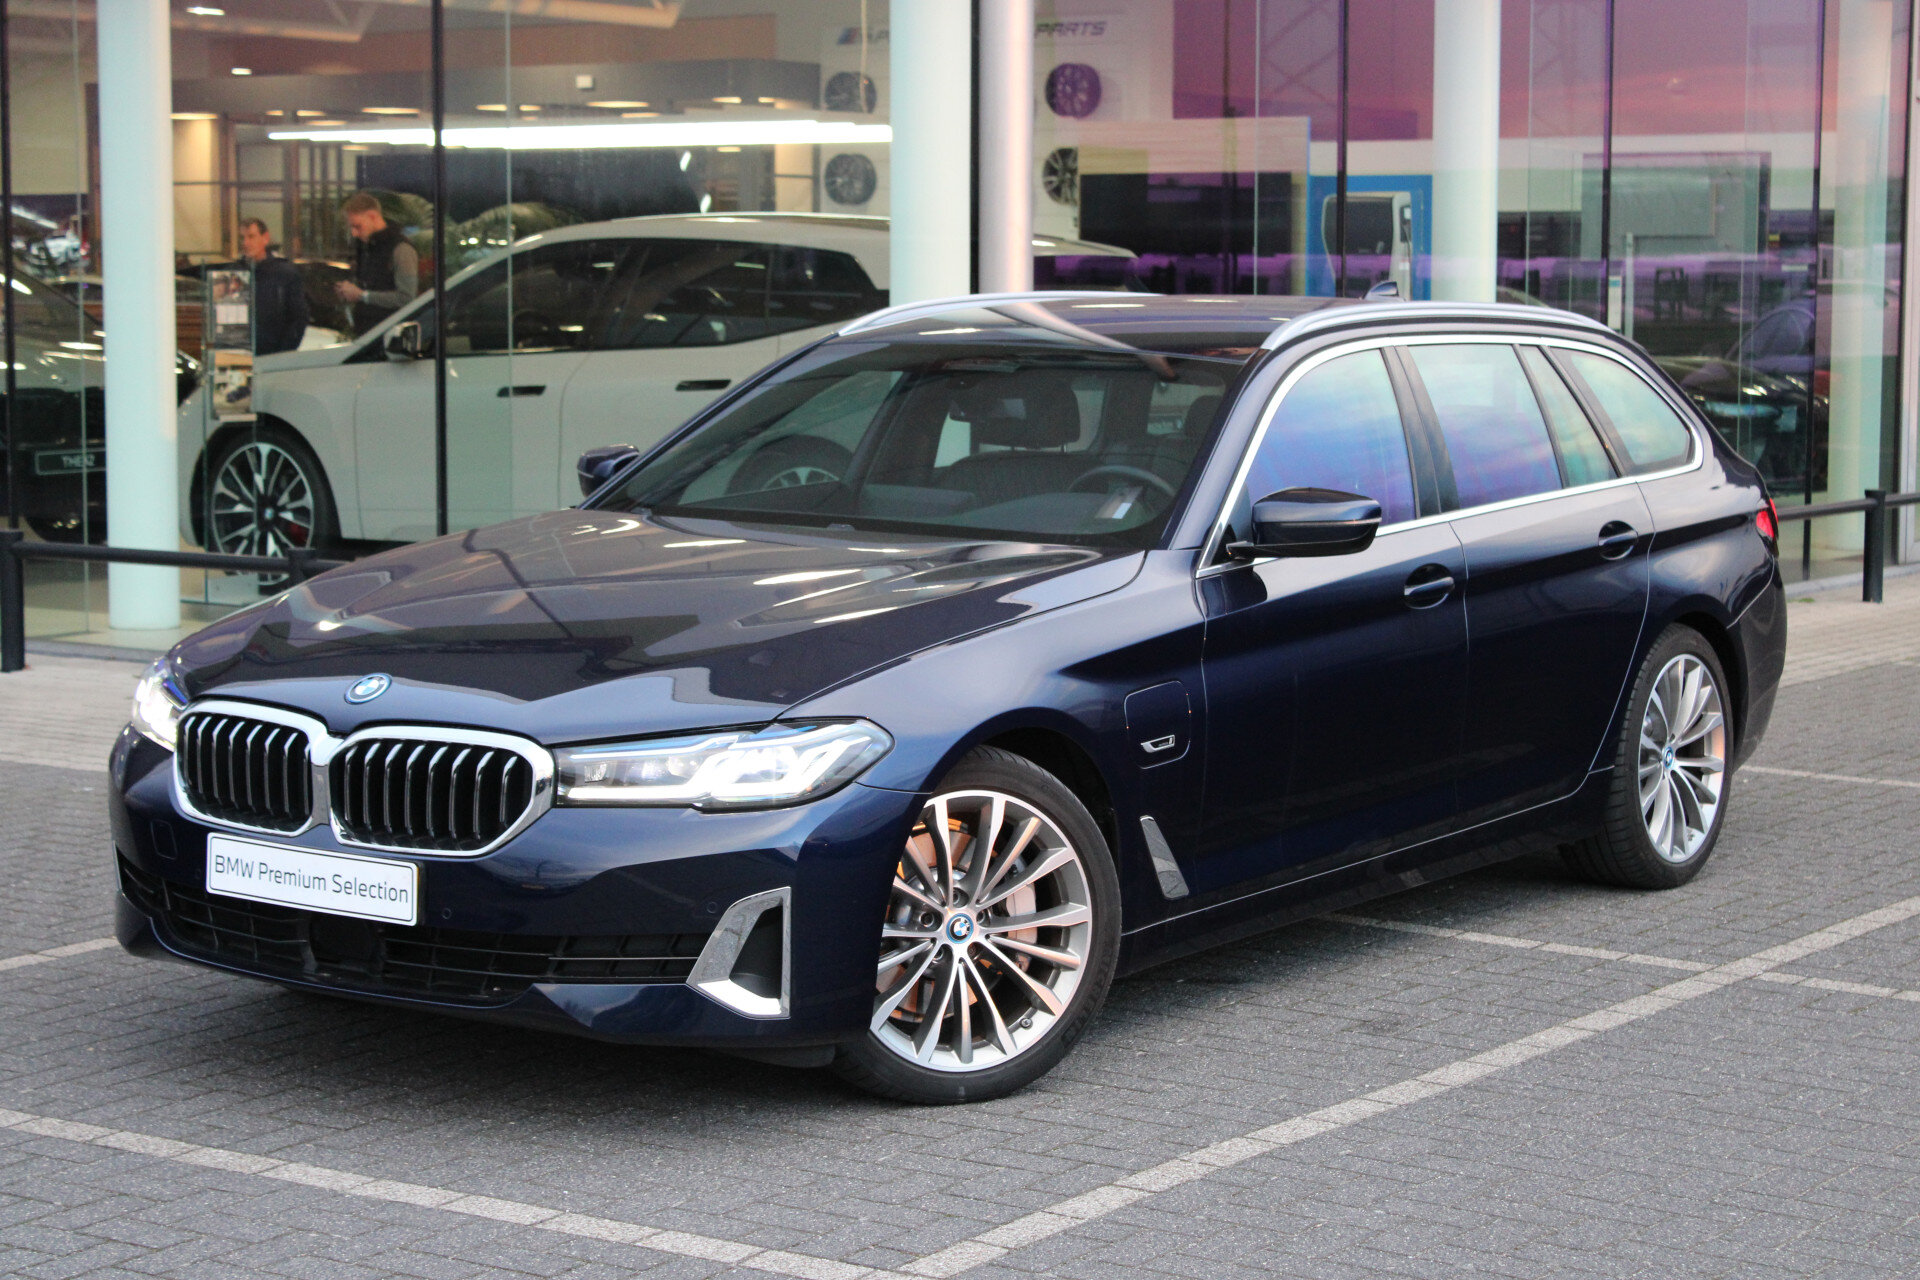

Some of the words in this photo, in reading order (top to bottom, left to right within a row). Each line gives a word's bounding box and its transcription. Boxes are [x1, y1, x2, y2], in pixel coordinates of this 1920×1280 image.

[215, 855, 254, 878] BMW
[259, 862, 326, 891] Premium
[332, 874, 408, 903] Selection
